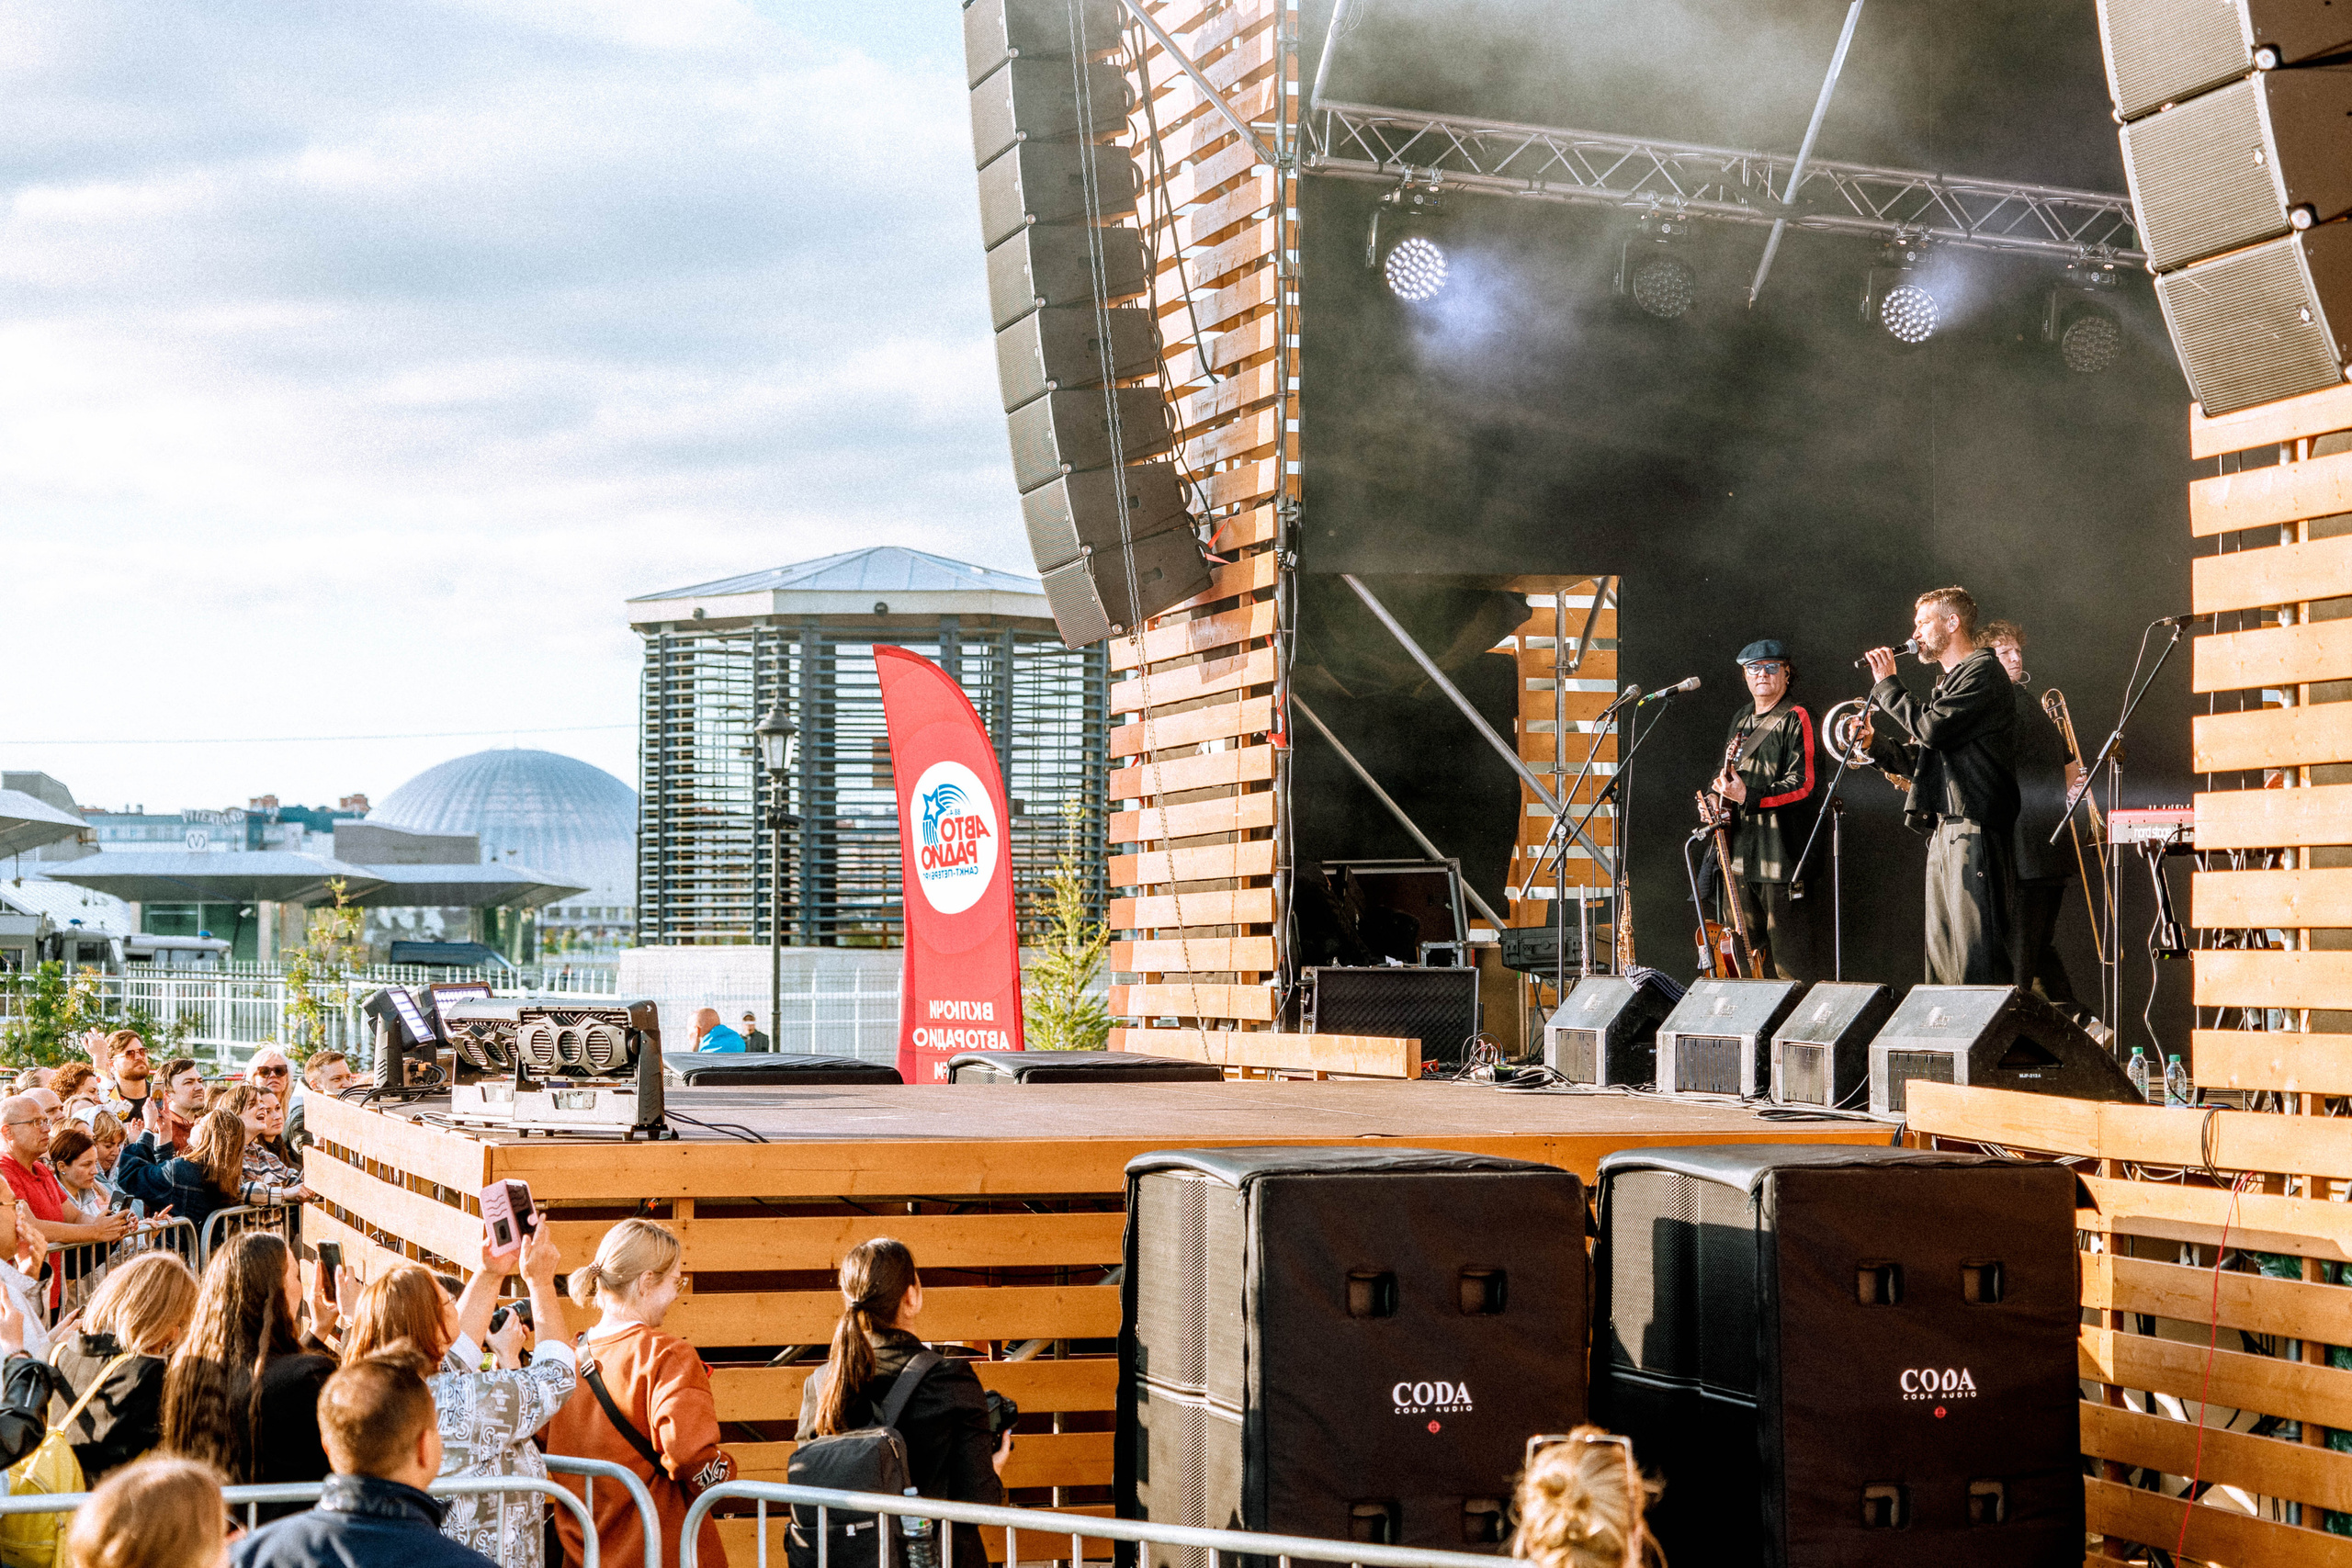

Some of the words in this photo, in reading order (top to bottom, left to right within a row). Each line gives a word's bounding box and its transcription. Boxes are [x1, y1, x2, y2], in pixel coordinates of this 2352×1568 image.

[1900, 1367, 1976, 1393] CODA
[1392, 1381, 1473, 1406] CODA
[1903, 1393, 1933, 1401] CODA
[1941, 1391, 1977, 1399] AUDIO
[1394, 1406, 1427, 1415] CODA
[1435, 1404, 1473, 1413] AUDIO
